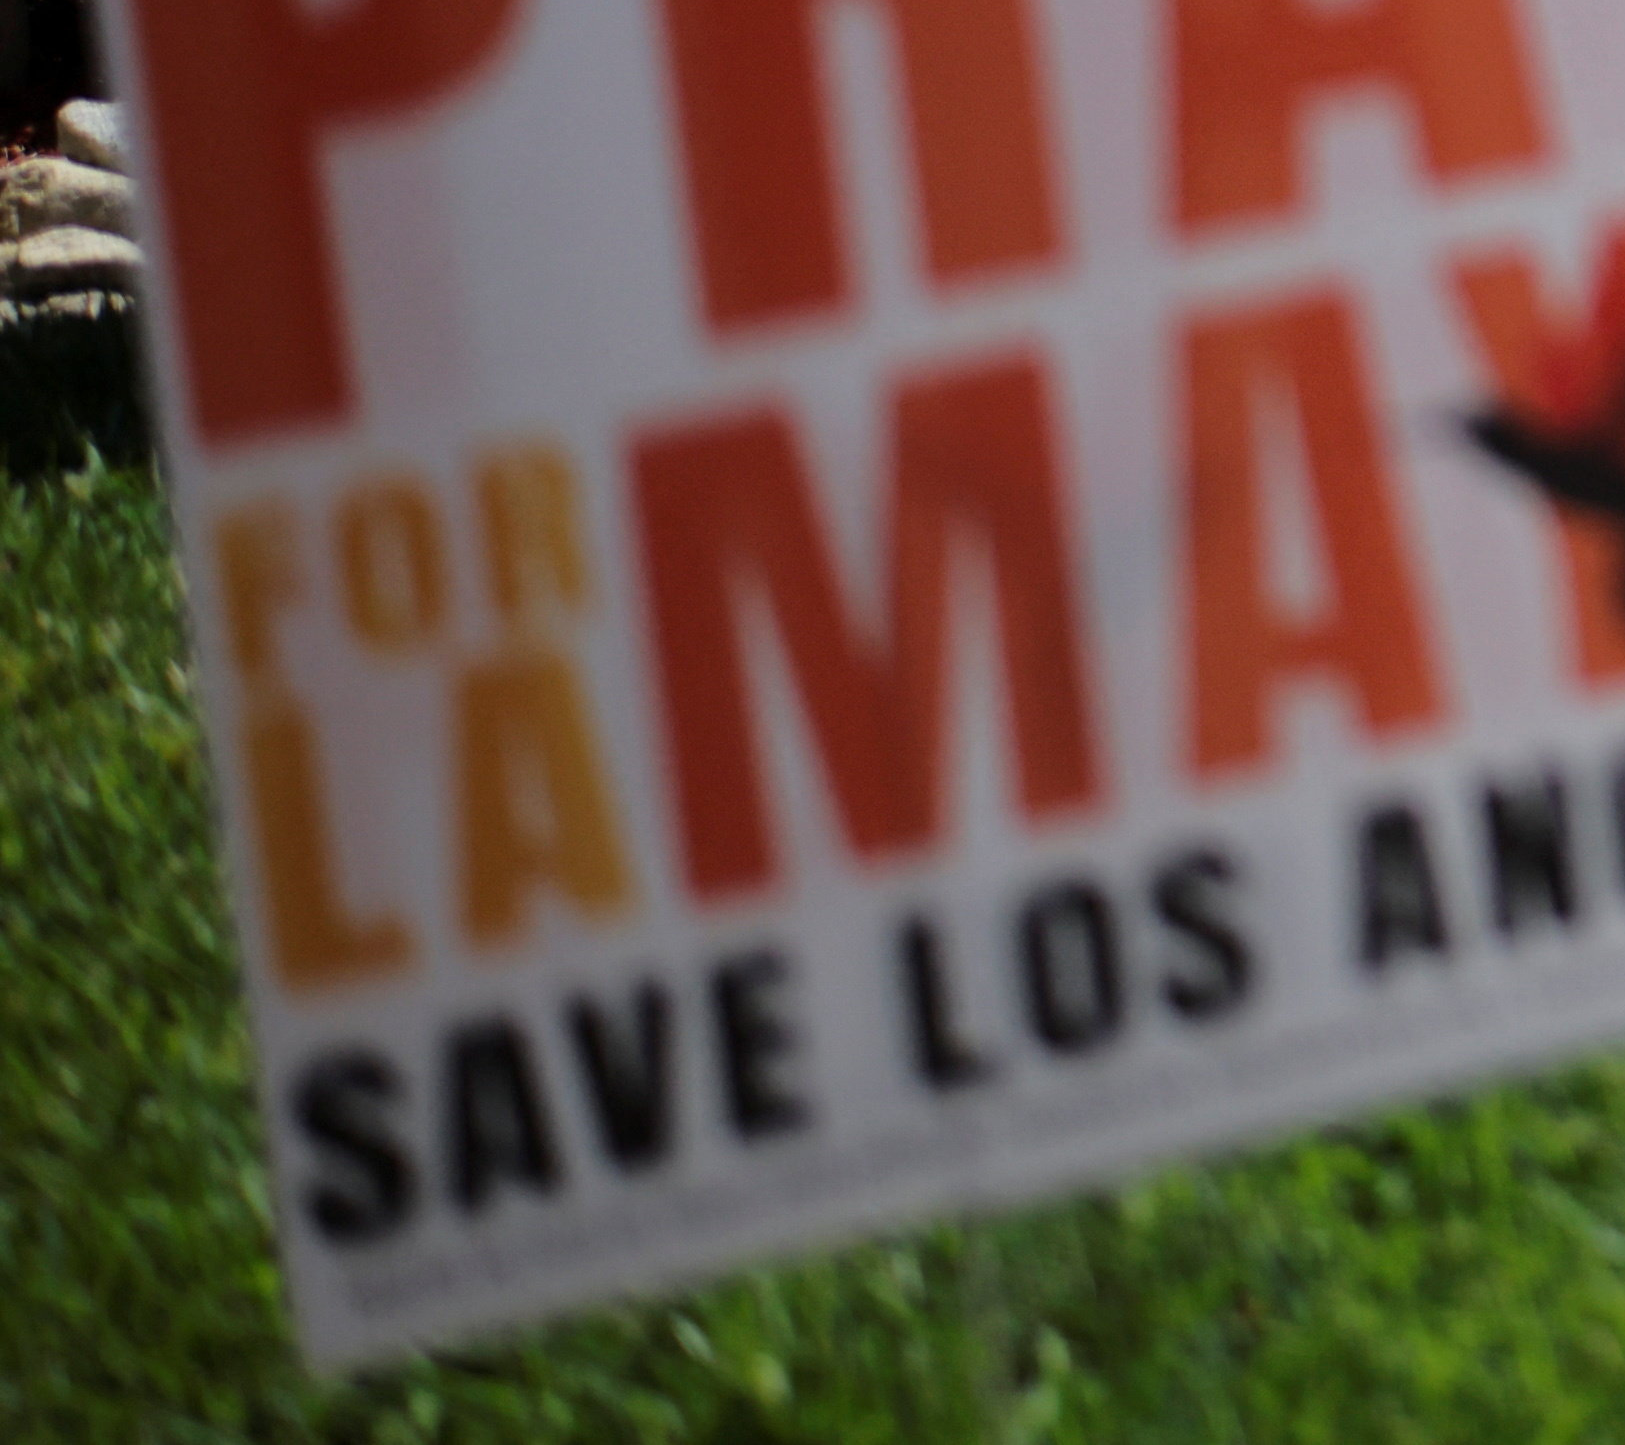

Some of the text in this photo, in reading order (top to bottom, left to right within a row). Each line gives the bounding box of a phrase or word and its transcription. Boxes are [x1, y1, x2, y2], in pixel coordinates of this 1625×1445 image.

[210, 444, 590, 680] FOR
[235, 633, 636, 998] LA
[286, 942, 808, 1252] SAVE
[890, 838, 1258, 1098] LOS
